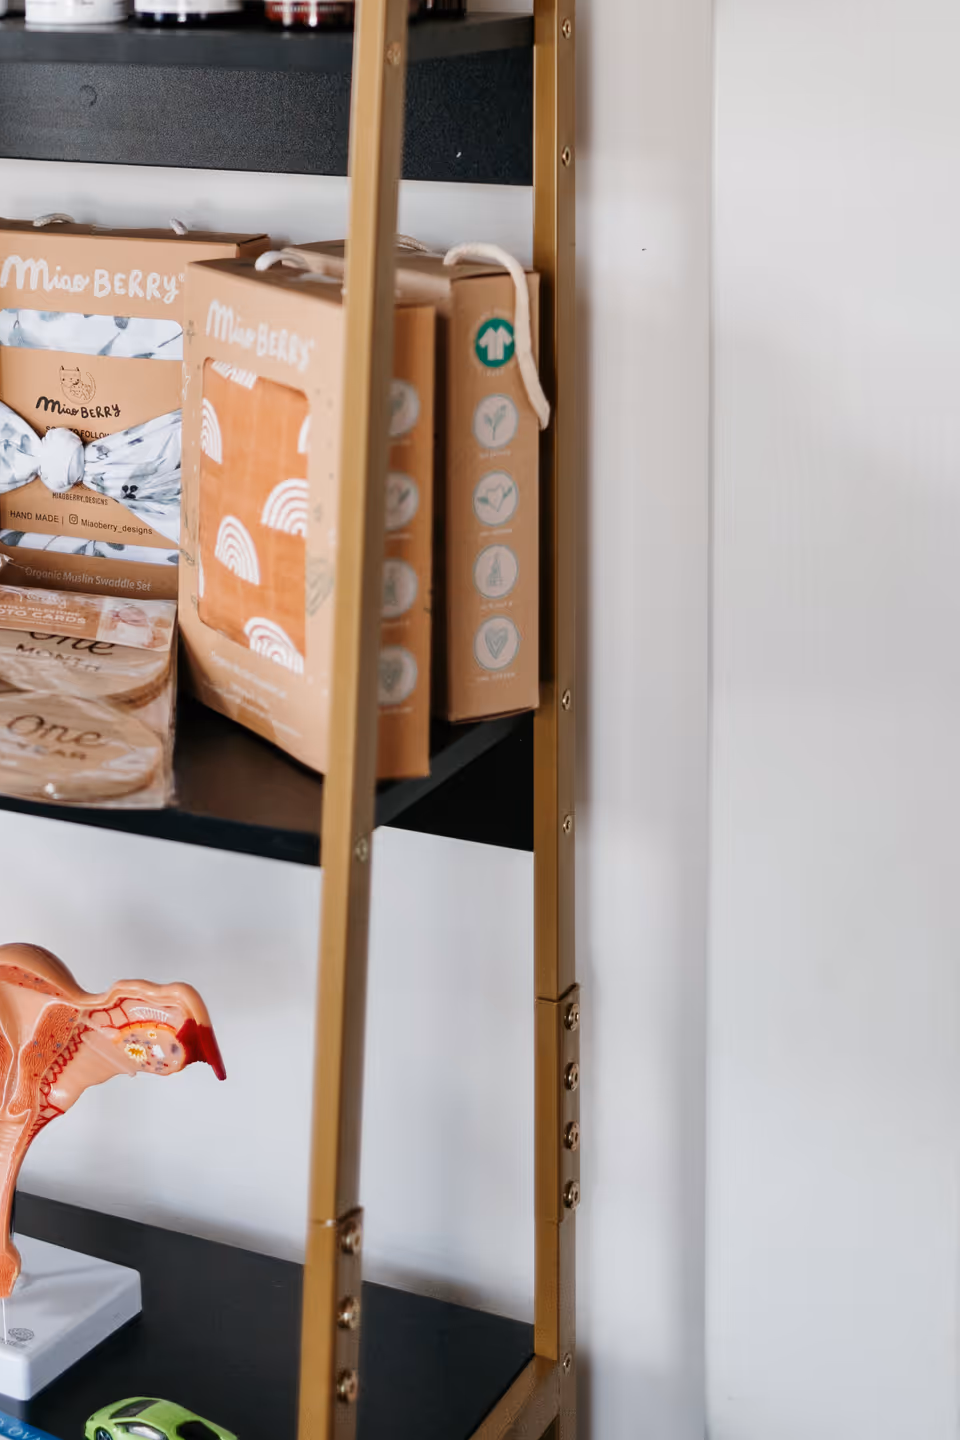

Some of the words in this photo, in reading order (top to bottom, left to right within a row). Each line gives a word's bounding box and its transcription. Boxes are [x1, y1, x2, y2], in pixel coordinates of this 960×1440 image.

[93, 269, 179, 304] BERRY
[80, 404, 121, 419] BERRY
[10, 510, 33, 520] HAND
[35, 512, 59, 523] MADE
[81, 518, 153, 535] Miaoberry_designs
[25, 566, 61, 580] Organic
[62, 571, 94, 584] Muslin
[95, 575, 135, 589] Swaddle
[136, 580, 152, 591] Set
[31, 611, 87, 624] CARDS
[6, 714, 108, 748] One
